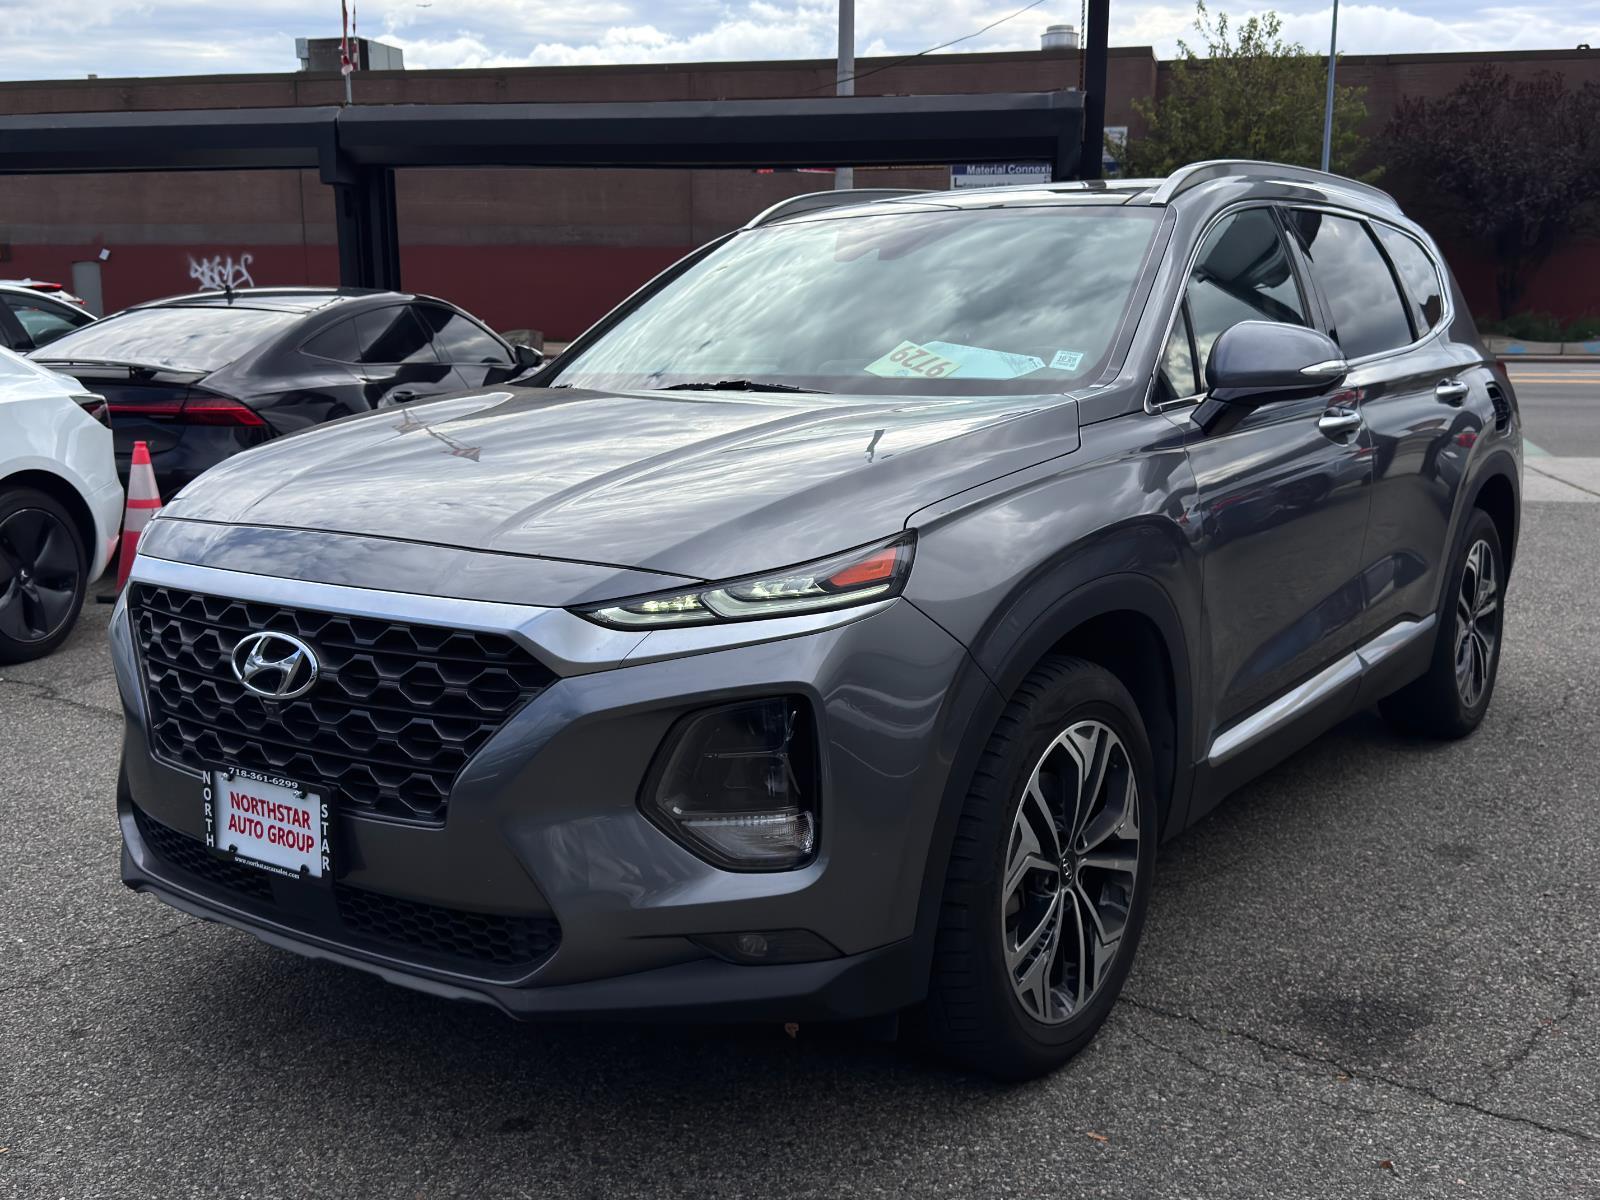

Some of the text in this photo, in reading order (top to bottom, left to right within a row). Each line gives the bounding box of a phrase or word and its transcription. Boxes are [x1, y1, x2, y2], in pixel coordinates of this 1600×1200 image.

[890, 346, 953, 378] 9729
[228, 767, 299, 789] 718-361-6299
[202, 770, 215, 848] NORTH
[230, 791, 312, 830] NORTHSTAR
[228, 813, 315, 853] AUTO GROUP
[320, 804, 331, 871] STAR
